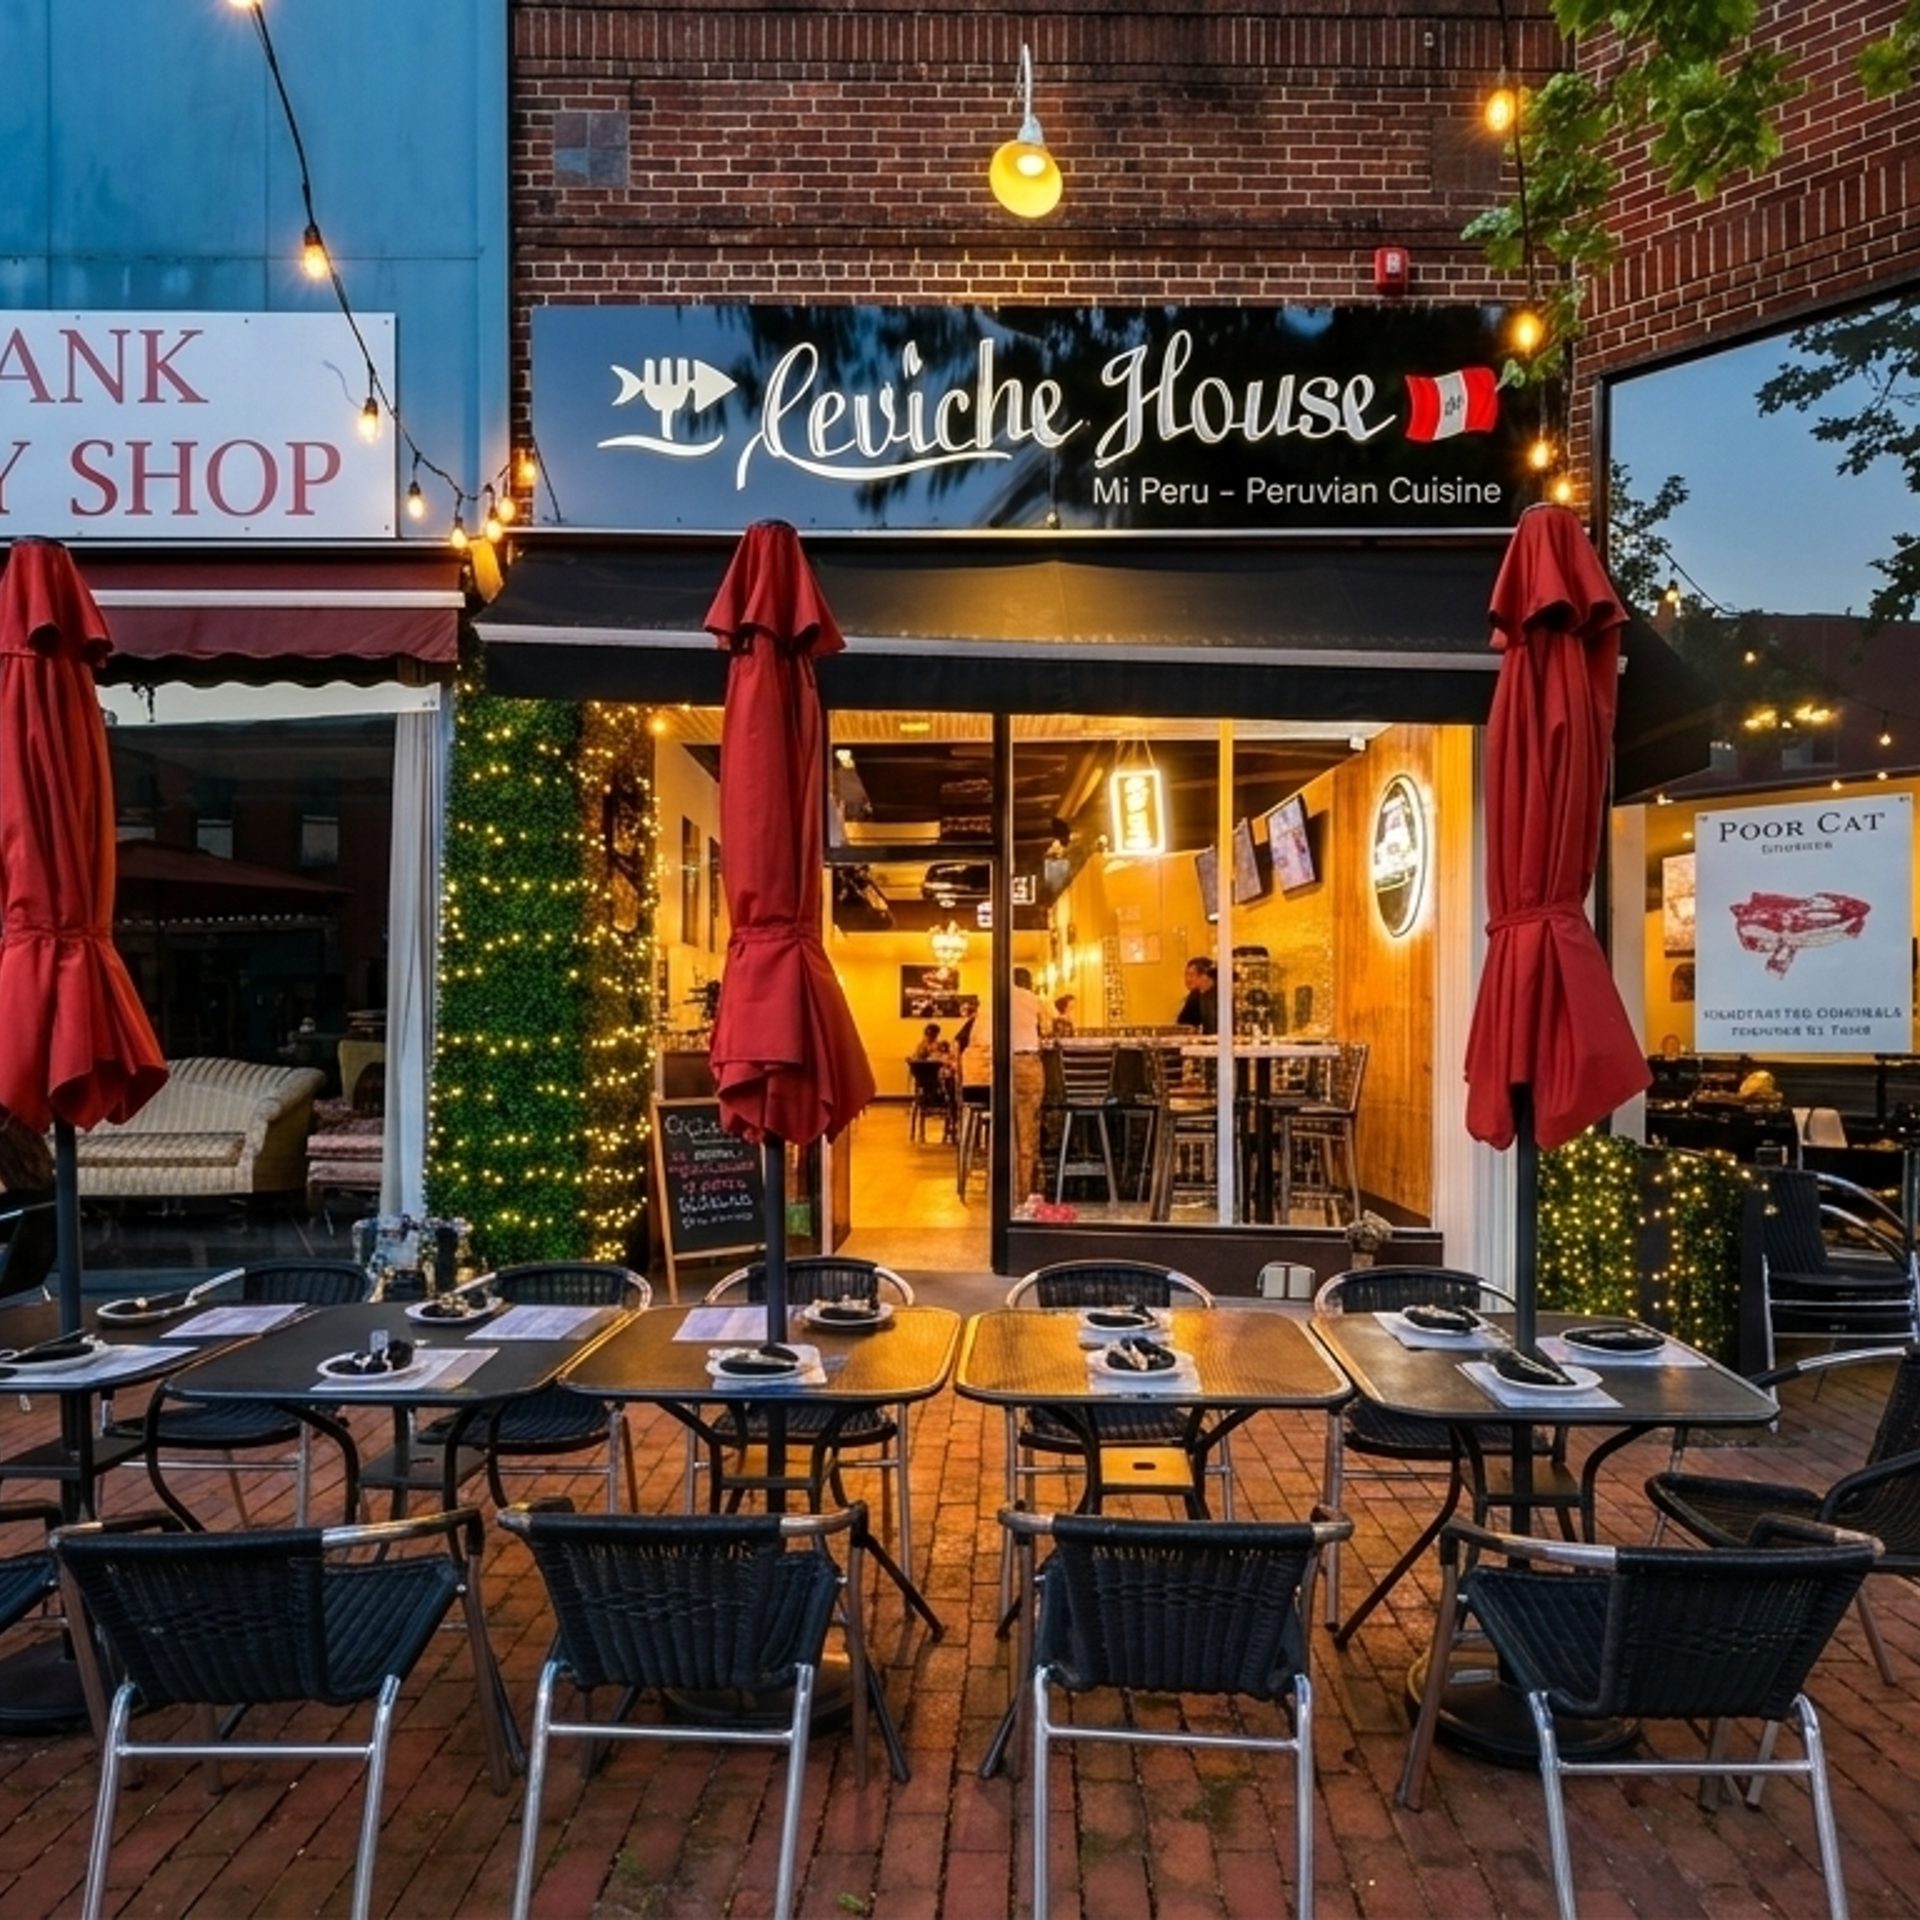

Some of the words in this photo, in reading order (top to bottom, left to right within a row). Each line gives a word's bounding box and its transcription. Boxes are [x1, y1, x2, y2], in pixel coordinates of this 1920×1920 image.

[0, 328, 209, 405] ANK
[1094, 329, 1397, 468] House
[71, 439, 341, 516] SHOP
[1093, 476, 1129, 504] Mi
[1140, 477, 1209, 504] Peru
[1246, 476, 1378, 504] Peruvian
[1389, 476, 1501, 504] Cuisine
[1719, 820, 1804, 843] POOR
[1817, 811, 1886, 834] CAT
